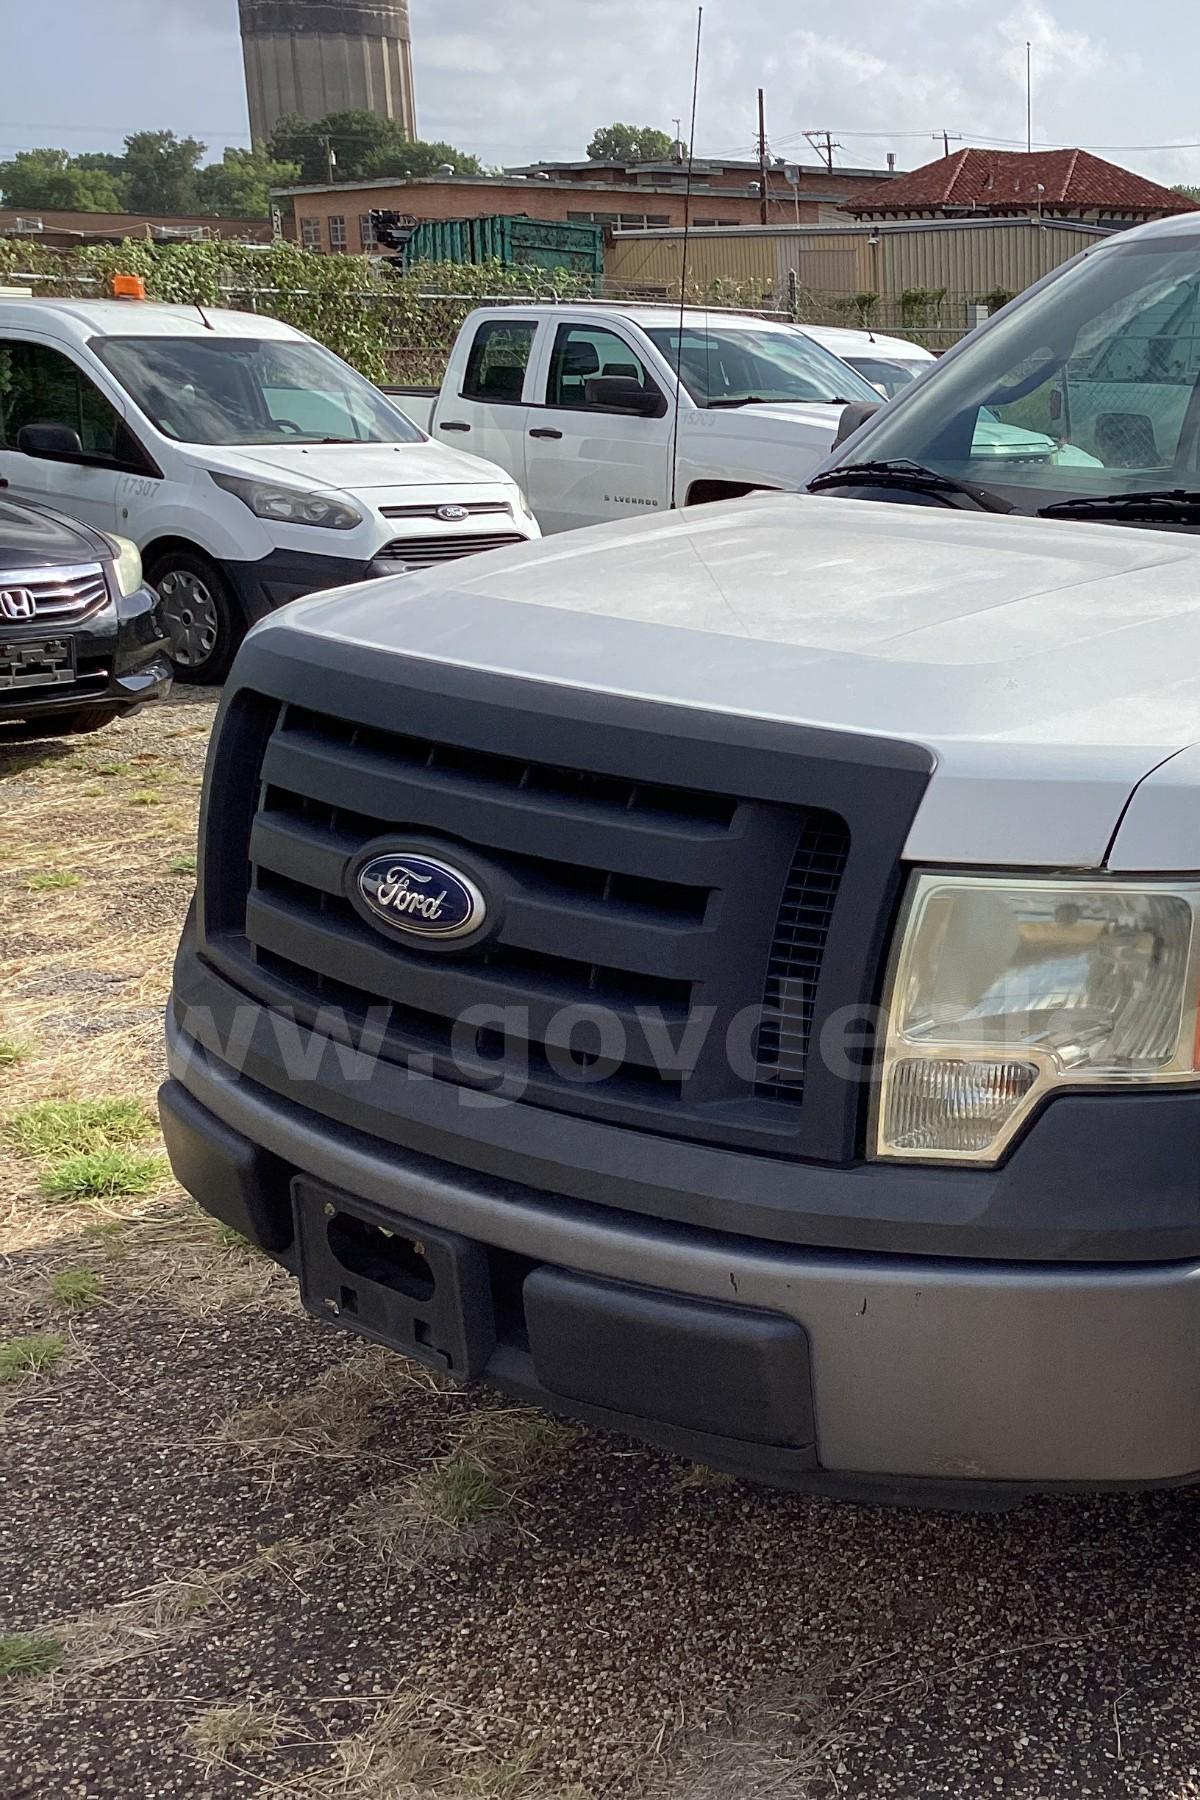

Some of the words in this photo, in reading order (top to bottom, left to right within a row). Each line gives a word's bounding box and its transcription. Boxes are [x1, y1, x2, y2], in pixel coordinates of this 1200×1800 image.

[122, 477, 161, 497] 17307
[603, 494, 658, 506] SLVERADO
[377, 866, 448, 920] Ford
